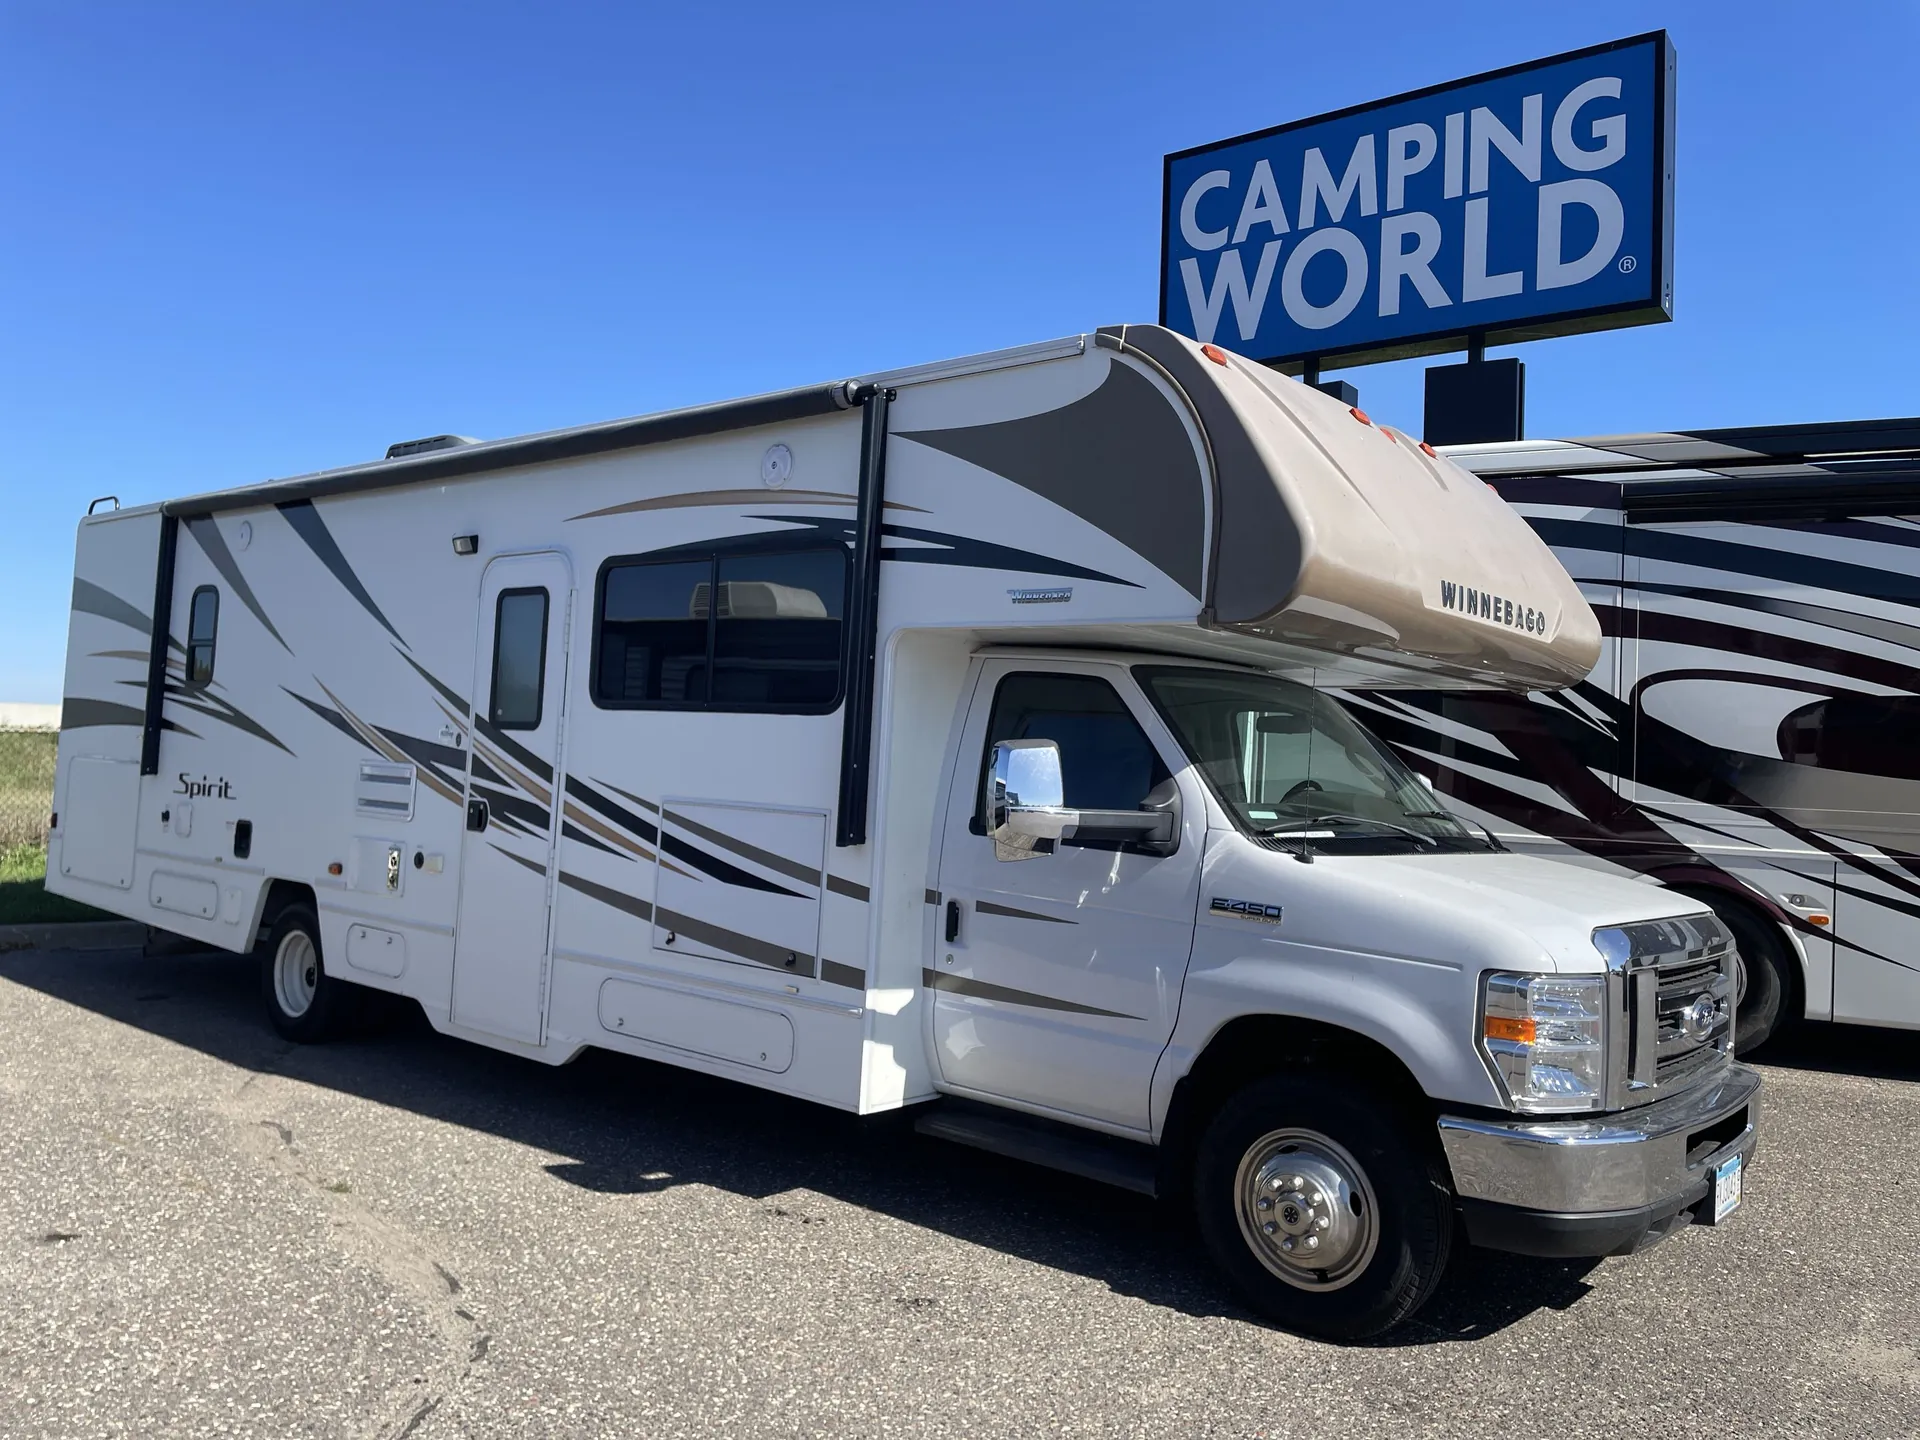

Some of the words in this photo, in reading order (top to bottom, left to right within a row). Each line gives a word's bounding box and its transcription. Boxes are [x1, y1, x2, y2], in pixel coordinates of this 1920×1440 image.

[1180, 77, 1627, 251] CAMPING
[1179, 178, 1625, 343] WORLD
[1440, 580, 1546, 636] WINNEBAGO
[173, 772, 237, 800] Spirit
